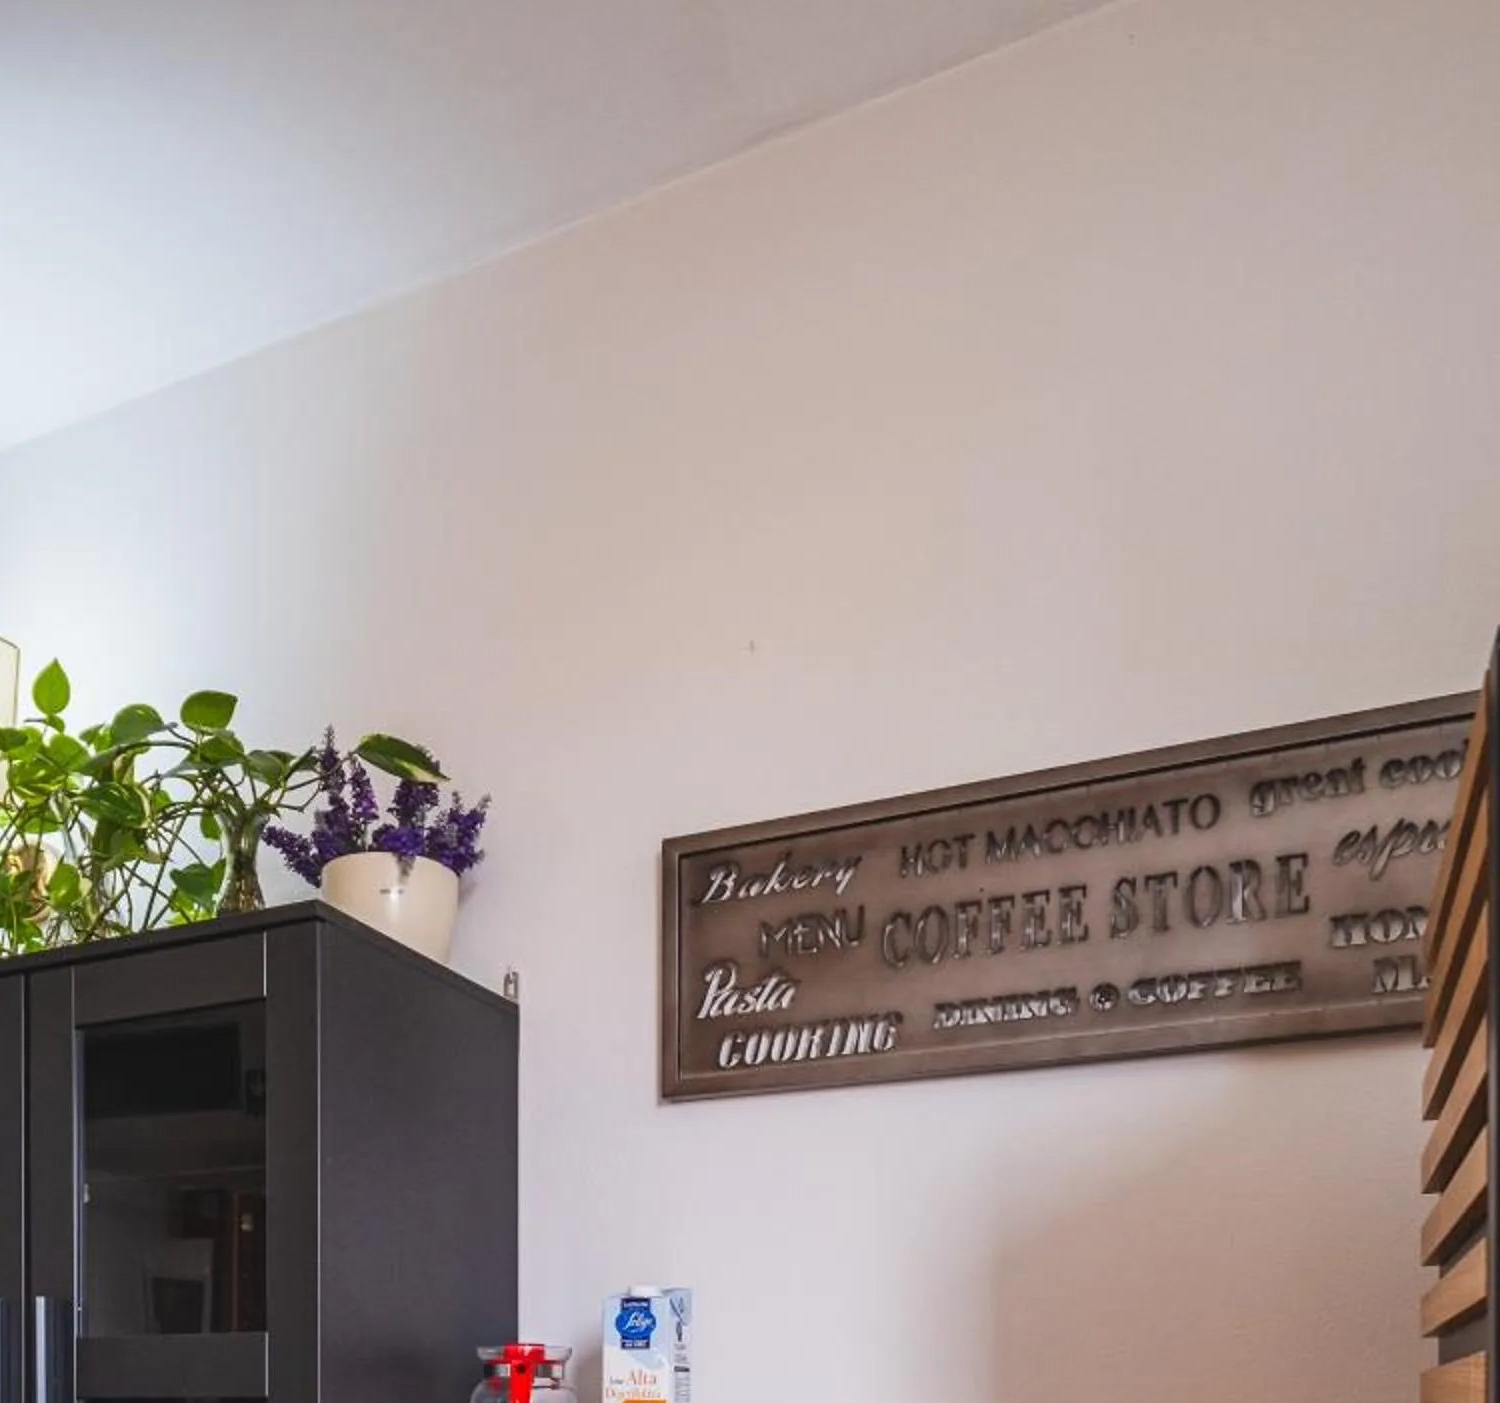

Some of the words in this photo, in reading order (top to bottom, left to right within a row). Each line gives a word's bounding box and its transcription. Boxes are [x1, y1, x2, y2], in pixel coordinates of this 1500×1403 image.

[1250, 757, 1367, 817] great
[1379, 739, 1470, 789] coo
[900, 833, 975, 878] HOT
[986, 793, 1221, 865] MACCHIATO
[696, 851, 863, 904] Bakery
[758, 905, 866, 956] MENU
[882, 884, 1089, 969] COFFEE
[1109, 852, 1310, 940] STORE
[697, 959, 799, 1020] Pasta
[933, 987, 1079, 1030] DINING
[1127, 961, 1302, 1006] COFFEE
[718, 1012, 904, 1069] COOKING
